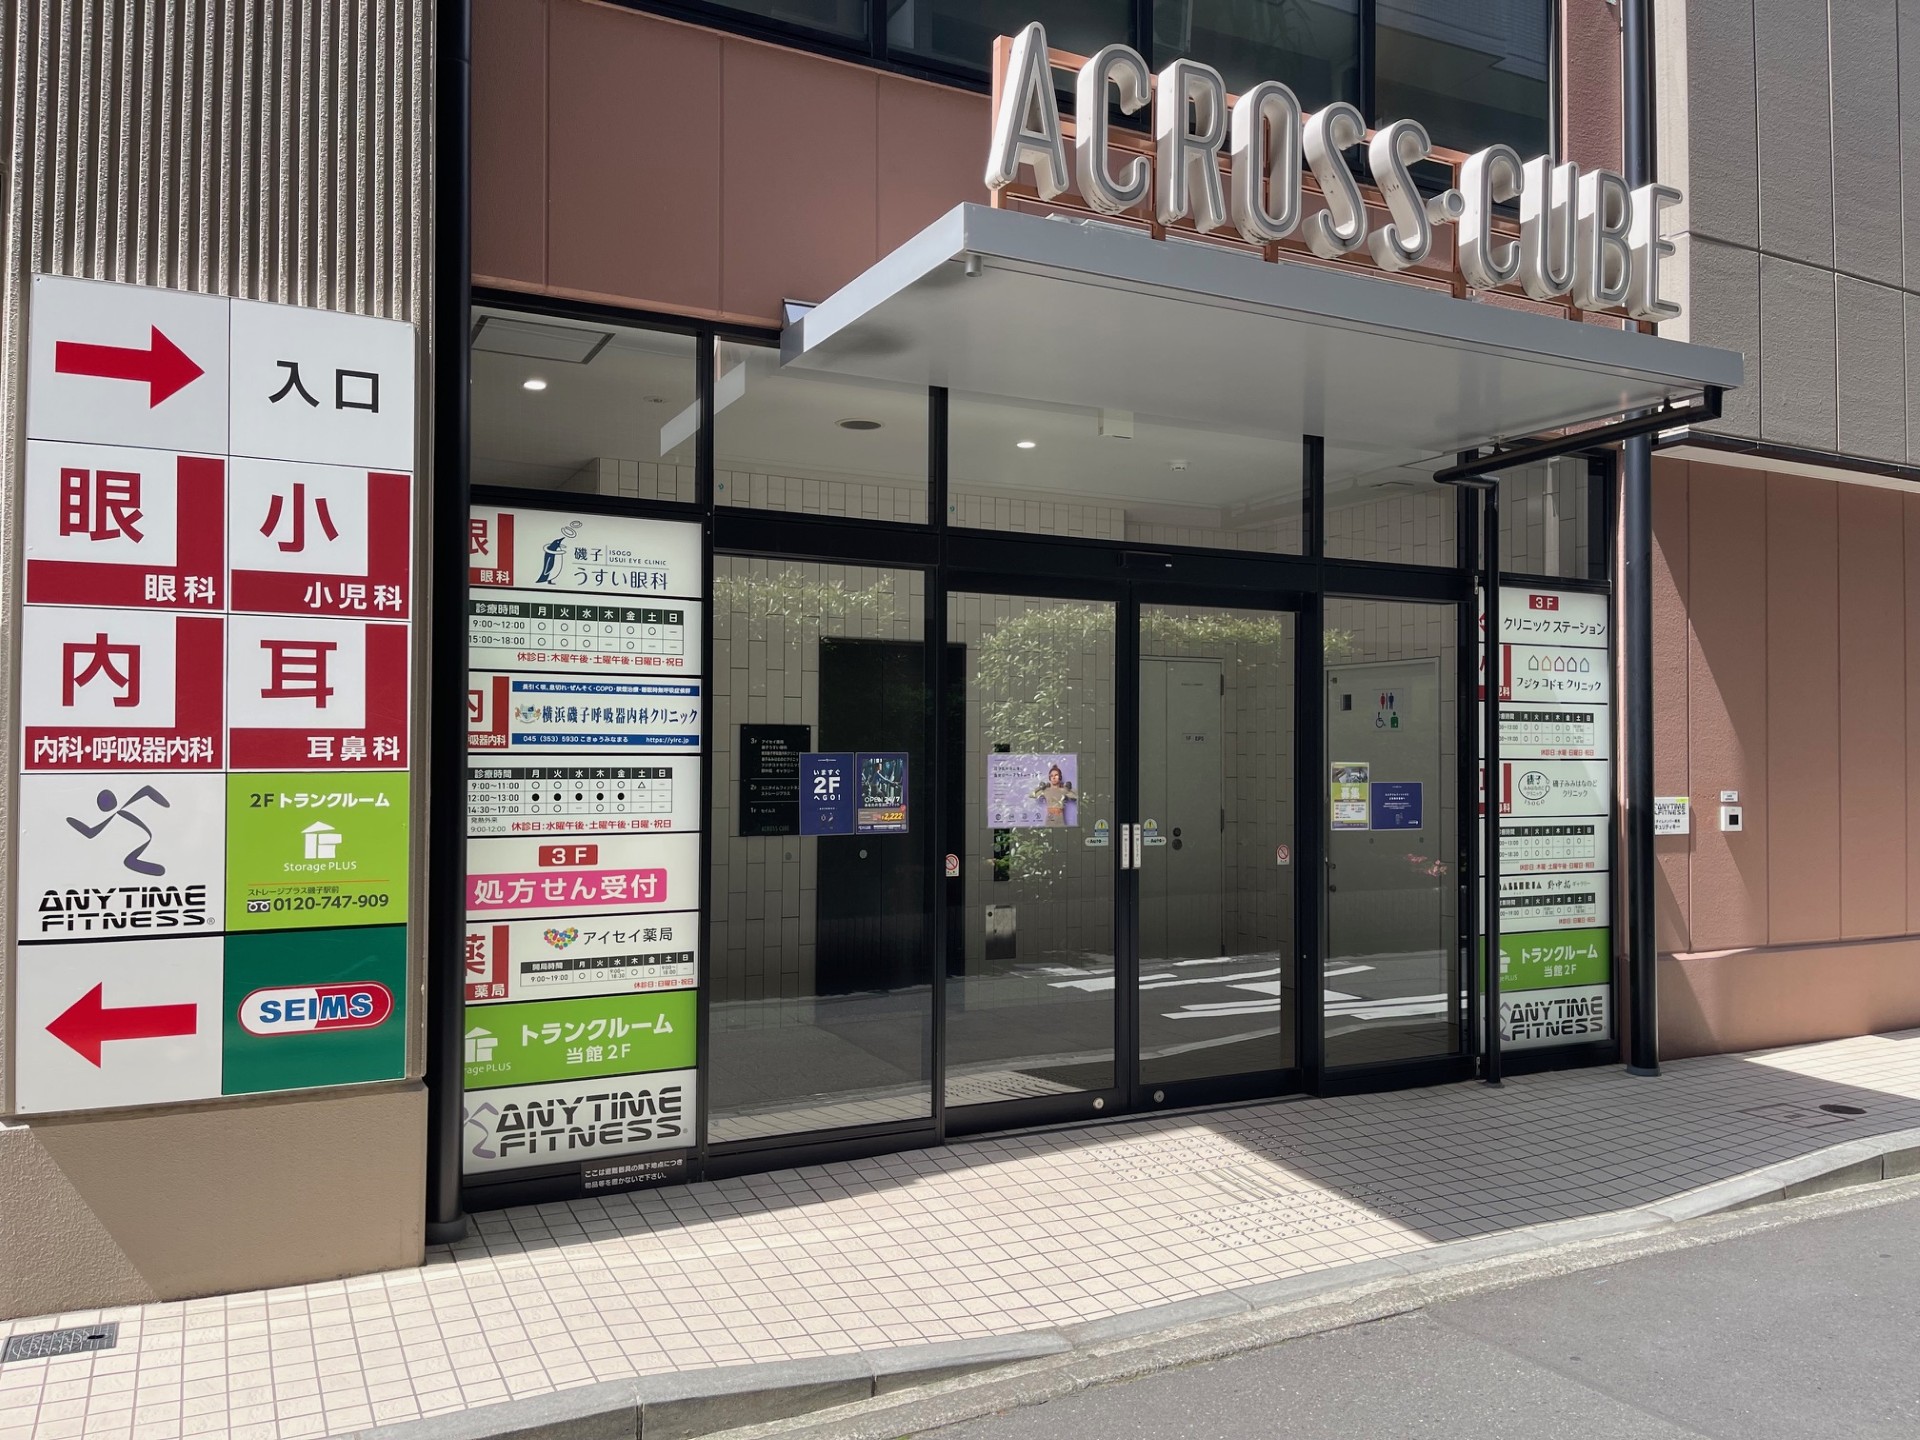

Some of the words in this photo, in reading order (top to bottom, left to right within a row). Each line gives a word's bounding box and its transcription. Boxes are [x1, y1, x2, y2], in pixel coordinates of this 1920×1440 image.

[268, 360, 380, 413] 入口
[59, 467, 145, 543] 眼
[259, 482, 339, 552] 小
[574, 547, 603, 562] 磯子
[480, 570, 511, 584] 眼科
[573, 568, 668, 590] うすい眼科
[144, 574, 216, 604] 眼科
[303, 582, 402, 611] 小児科
[476, 602, 520, 616] 診療時間
[538, 606, 546, 616] 月
[560, 608, 570, 618] 火
[582, 608, 592, 618] 水
[604, 610, 614, 620] 木
[626, 611, 636, 621] 金
[648, 612, 657, 622] 土
[669, 613, 678, 623] 日
[472, 619, 525, 630] 9:00~12:00
[62, 633, 141, 707] 内
[260, 639, 338, 708] 耳
[1516, 678, 1540, 689] フジタ
[1542, 678, 1564, 690] コドモ
[1566, 679, 1602, 692] クリニック
[543, 704, 698, 725] 横浜磯子呼吸器内科クリニック
[33, 736, 214, 764] 内科・呼吸器内科
[307, 736, 400, 762] 耳鼻科
[474, 769, 512, 778] 診療時間
[532, 769, 540, 778] 月
[554, 769, 562, 778] 火
[575, 769, 584, 778] 水
[596, 769, 604, 778] 木
[617, 769, 626, 778] 金
[638, 769, 646, 778] 土
[658, 769, 666, 778] 日
[814, 776, 840, 794] 2F
[1562, 790, 1588, 798] クリニック
[250, 793, 275, 808] 2F
[279, 792, 391, 809] トランクルーム
[468, 806, 520, 814] 14:30~17:00
[283, 862, 327, 873] Storage
[328, 861, 357, 871] PLUS
[38, 884, 206, 912] ANYTIME
[474, 874, 658, 905] 処方せん受付
[273, 894, 389, 911] 0120-747-909
[41, 909, 206, 932] FITNESS
[584, 926, 673, 946] アイセイ薬局
[1521, 944, 1598, 964] トランクルーム
[531, 974, 568, 983] 9:00~19:00
[474, 984, 506, 998] 薬局
[258, 993, 373, 1024] SEIMS
[1510, 996, 1602, 1024] ANYTIME
[522, 1014, 674, 1046] トランクルーム
[1512, 1016, 1602, 1041] FITNESS
[486, 1062, 512, 1072] PLUS
[496, 1086, 682, 1133] ANYTIME
[500, 1115, 682, 1157] FITNESS
